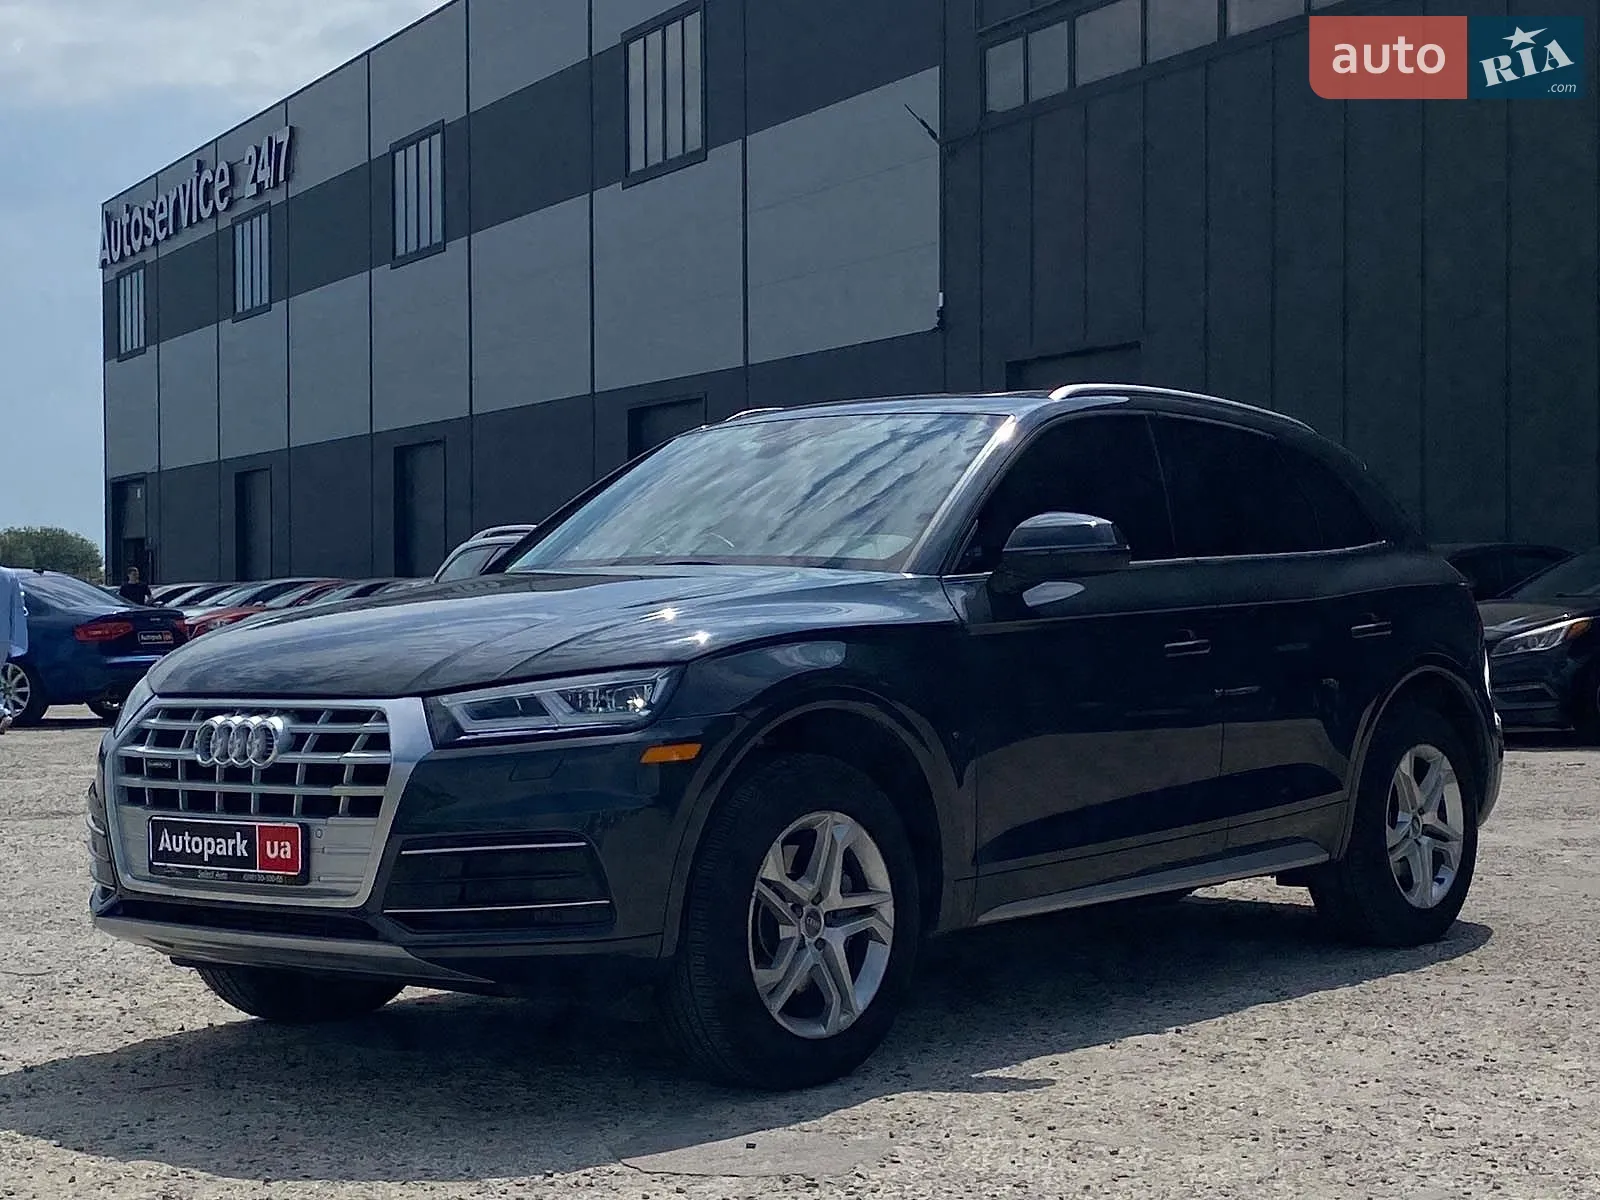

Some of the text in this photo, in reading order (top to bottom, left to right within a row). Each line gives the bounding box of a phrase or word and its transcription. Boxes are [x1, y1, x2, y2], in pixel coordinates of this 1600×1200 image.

[99, 125, 293, 266] Autoservice 24/7
[158, 827, 292, 862] Autopark ua
